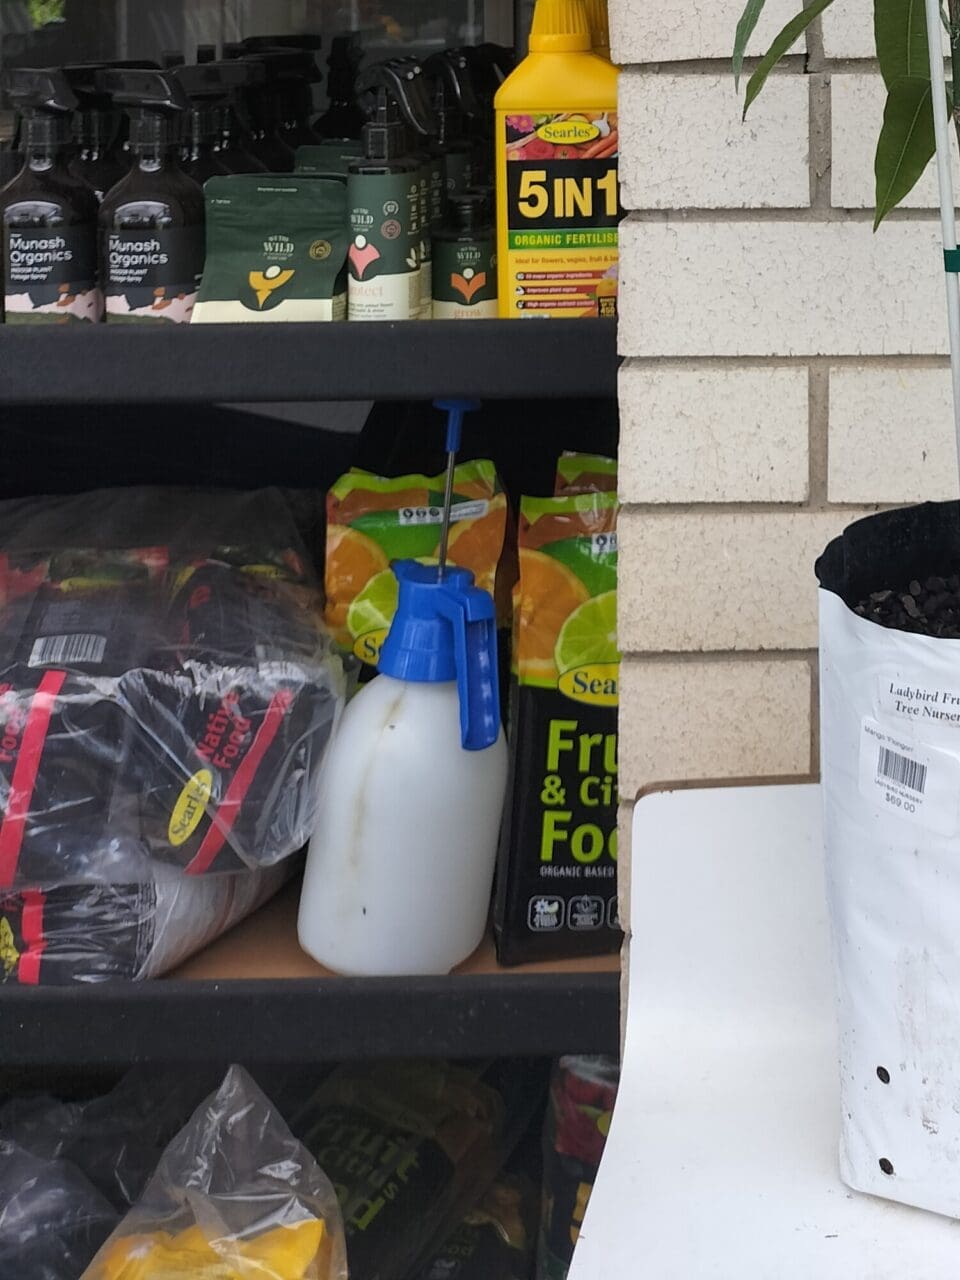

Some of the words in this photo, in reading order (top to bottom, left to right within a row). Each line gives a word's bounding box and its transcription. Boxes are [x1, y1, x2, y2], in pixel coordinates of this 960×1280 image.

[544, 126, 591, 139] Searles
[518, 170, 549, 218] 5
[554, 177, 593, 218] IN
[10, 236, 65, 251] Munash
[109, 239, 160, 252] Munash
[263, 242, 294, 253] WILD
[514, 235, 562, 245] ORGANIC
[10, 250, 73, 265] Organics
[109, 252, 168, 267] Organics
[889, 683, 939, 702] Ladybird
[895, 700, 919, 715] Tree
[213, 715, 252, 768] Food
[540, 775, 566, 805] &
[171, 782, 210, 836] Searles
[540, 865, 581, 877] ORGANIC
[585, 865, 615, 877] BASED
